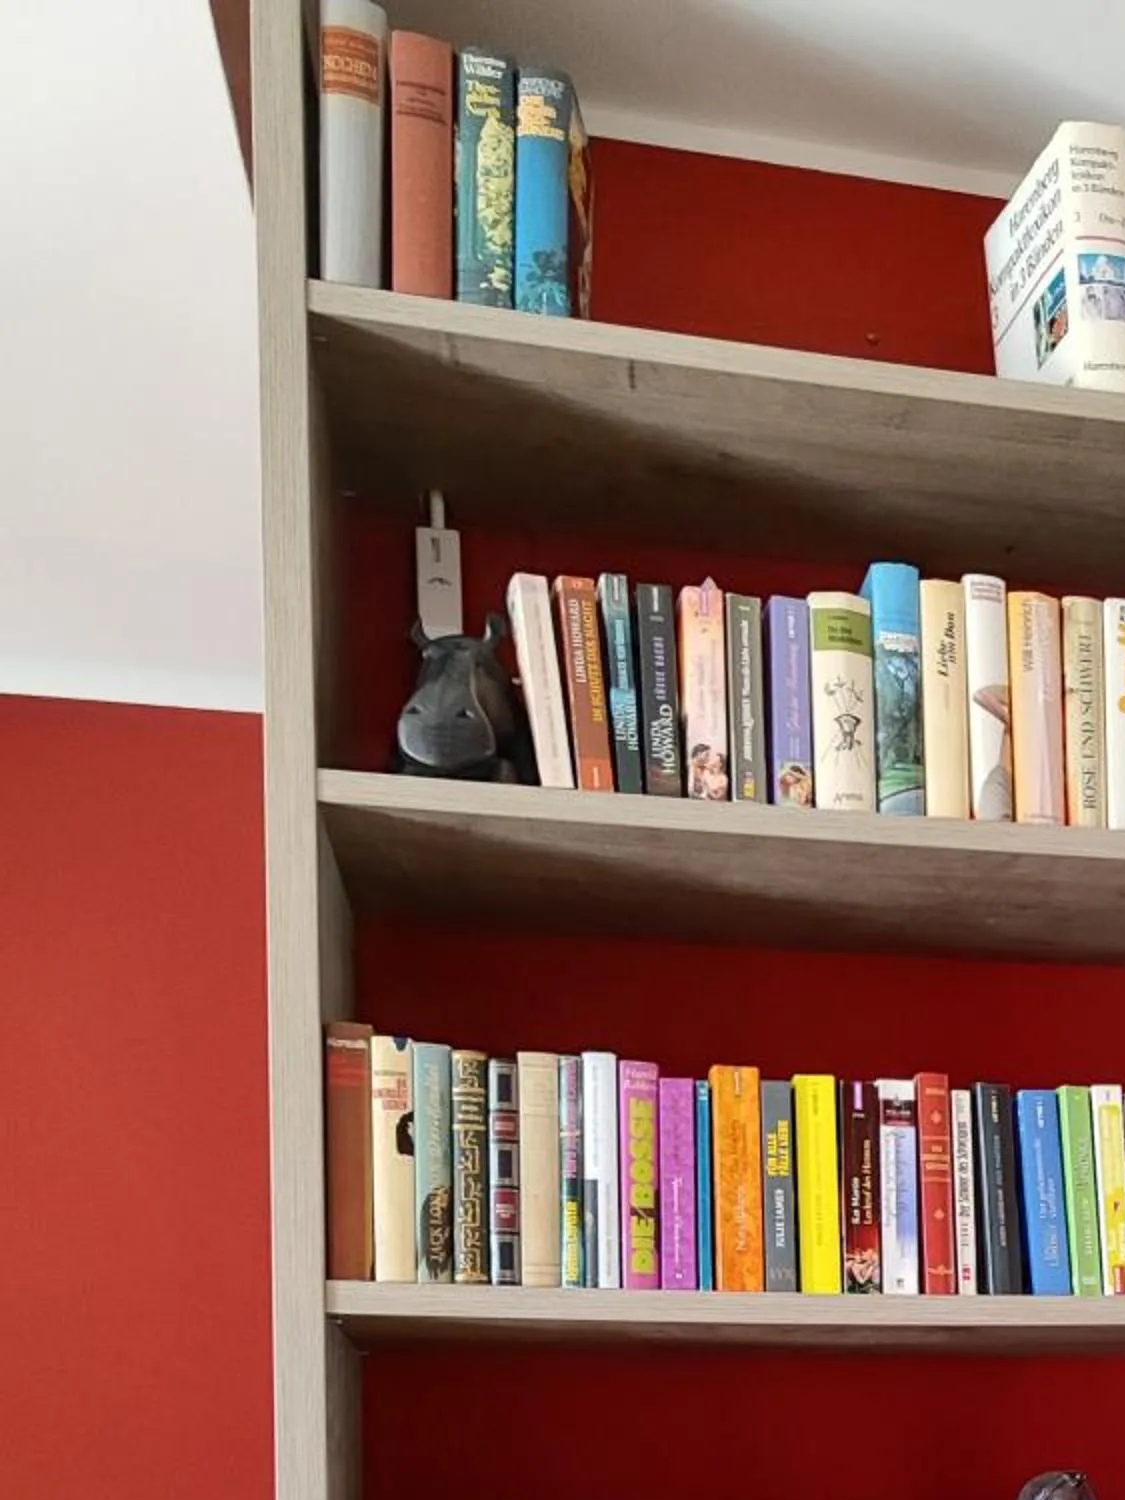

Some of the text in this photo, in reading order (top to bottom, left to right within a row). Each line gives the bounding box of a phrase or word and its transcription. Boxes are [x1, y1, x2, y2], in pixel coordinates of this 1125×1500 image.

[568, 598, 587, 682] LINDA HOWARD
[651, 719, 662, 758] LINDA
[659, 703, 675, 774] HOWARD
[1078, 634, 1097, 809] ROSE UND SCHWERT
[629, 1098, 657, 1274] DIE BOSSE
